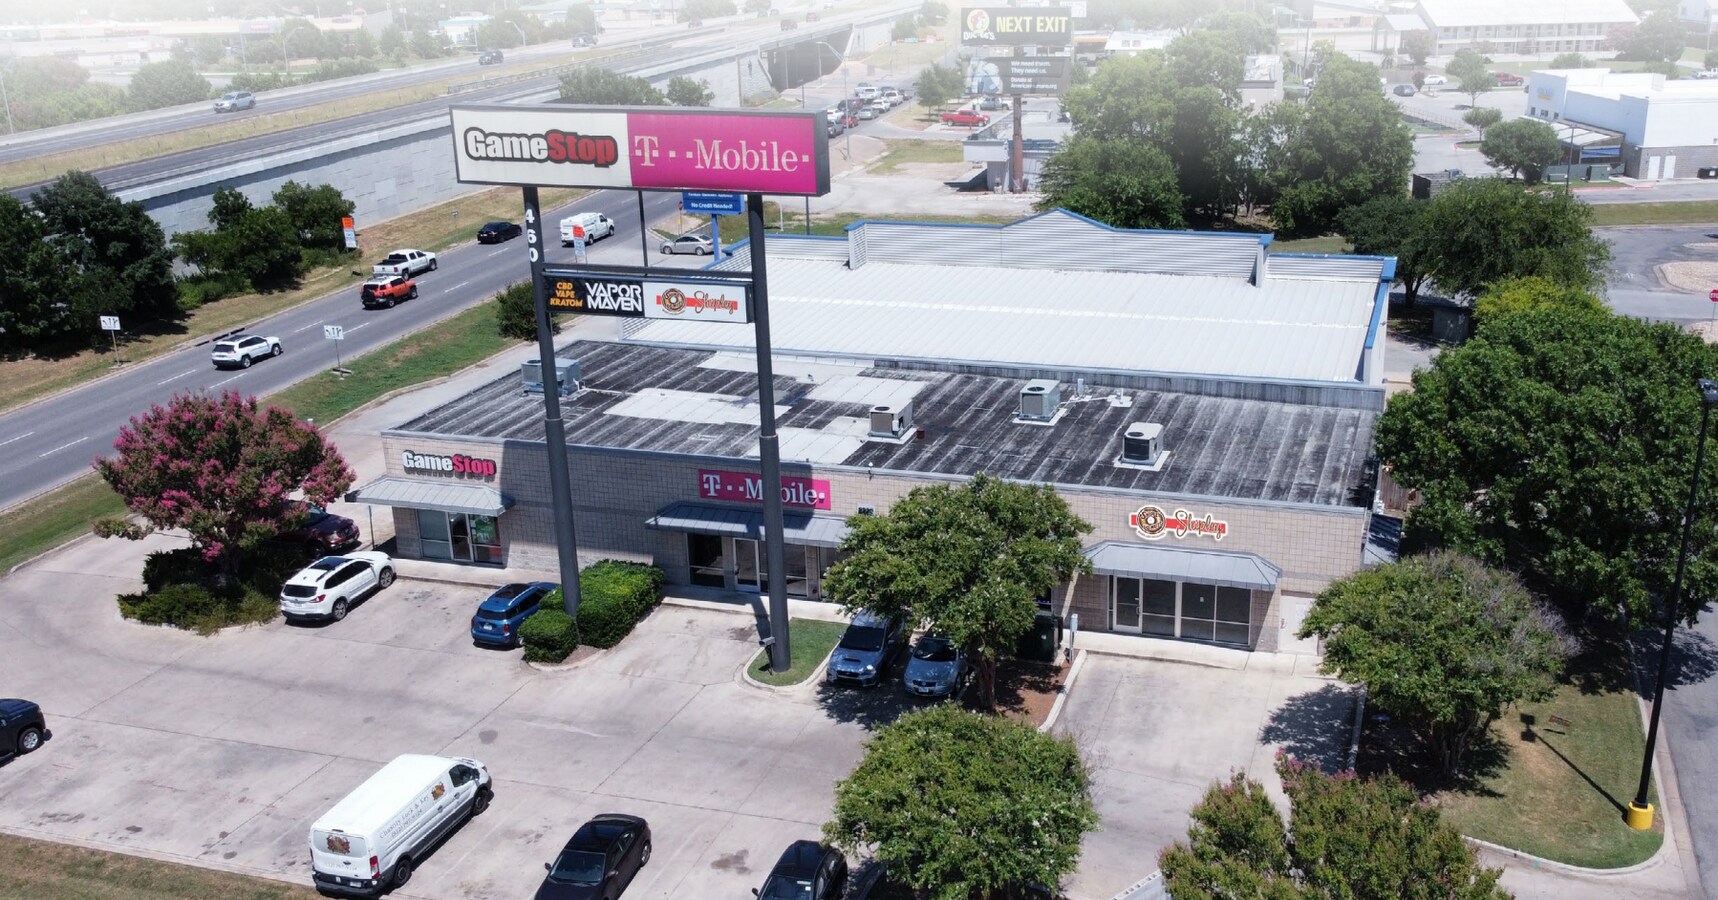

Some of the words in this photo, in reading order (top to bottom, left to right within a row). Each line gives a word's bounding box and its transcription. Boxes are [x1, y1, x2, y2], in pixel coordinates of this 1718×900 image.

[996, 16, 1032, 33] NEXT
[1036, 16, 1068, 33] EXIT
[1011, 67, 1025, 75] They
[465, 128, 617, 167] GameStop
[525, 209, 539, 262] 460
[556, 281, 573, 290] CBD
[585, 282, 641, 299] VAPOR
[550, 298, 583, 307] KRATOM
[555, 290, 576, 299] VAPE
[693, 290, 734, 315] Shipley
[586, 295, 642, 312] MAVEN
[402, 450, 497, 477] GameStop
[1174, 510, 1225, 540] Shipley
